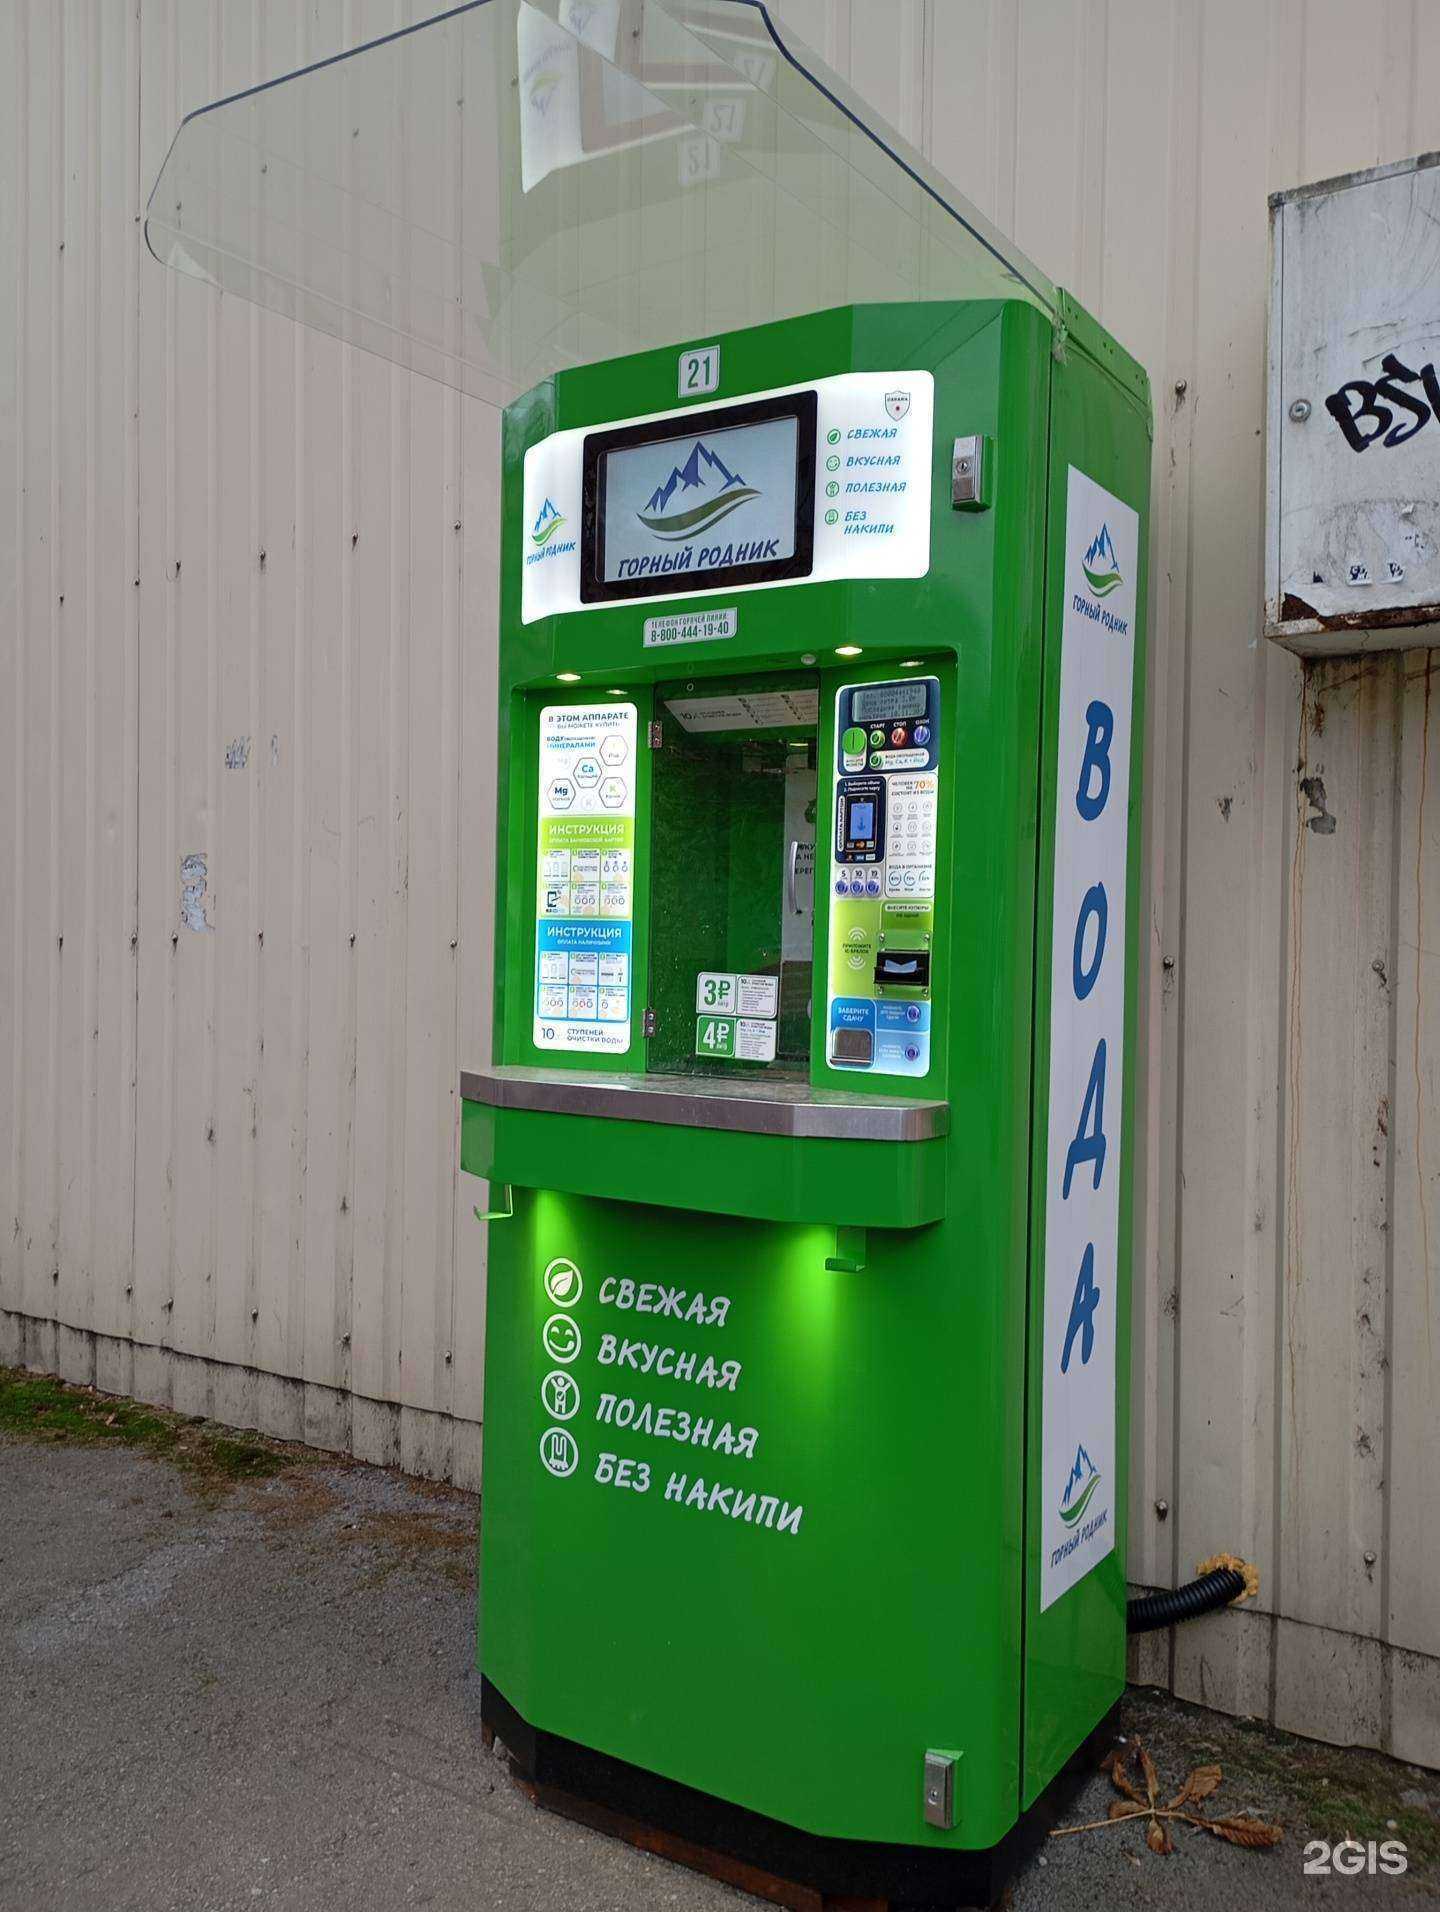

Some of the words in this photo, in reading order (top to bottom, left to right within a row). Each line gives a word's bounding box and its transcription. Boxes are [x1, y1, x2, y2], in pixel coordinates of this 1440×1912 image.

[688, 356, 710, 388] 21
[847, 428, 897, 439] СВЕЖАЯ
[846, 455, 900, 467] ВКУСНАЯ
[845, 482, 906, 493] ПОЛЕЗНАЯ
[845, 511, 866, 521] БЕЗ
[844, 524, 894, 535] НАКИПИ
[545, 542, 576, 559] РОДНИК
[618, 546, 693, 578] ГОРНЫЙ
[698, 539, 779, 568] РОДНИК
[1072, 594, 1101, 622] ГОРНЫЙ
[1101, 610, 1128, 636] РОДНИК
[651, 620, 729, 642] 8-800-444-19-40
[582, 712, 628, 721] АППАРАТЕ
[582, 765, 594, 773] Ca
[914, 780, 935, 790] 70%
[554, 787, 568, 796] Mg
[549, 824, 625, 834] ИНСТРУКЦИЯ
[547, 926, 622, 938] ИНСТРУКЦИЯ
[838, 1007, 869, 1015] ЗАБЕРИТЕ
[541, 1028, 555, 1040] 10
[567, 1028, 604, 1036] СТУПЕНЕЙ
[599, 1277, 731, 1327] СВЕЖАЯ
[597, 1334, 742, 1392] ВКУСНАЯ
[596, 1394, 759, 1459] ПОЛЕЗНАЯ
[594, 1453, 651, 1493] БЕЗ
[664, 1472, 803, 1535] НАКИПИ
[1051, 1529, 1080, 1568] ГОРНЫЙ
[1080, 1508, 1108, 1544] РОДНИК
